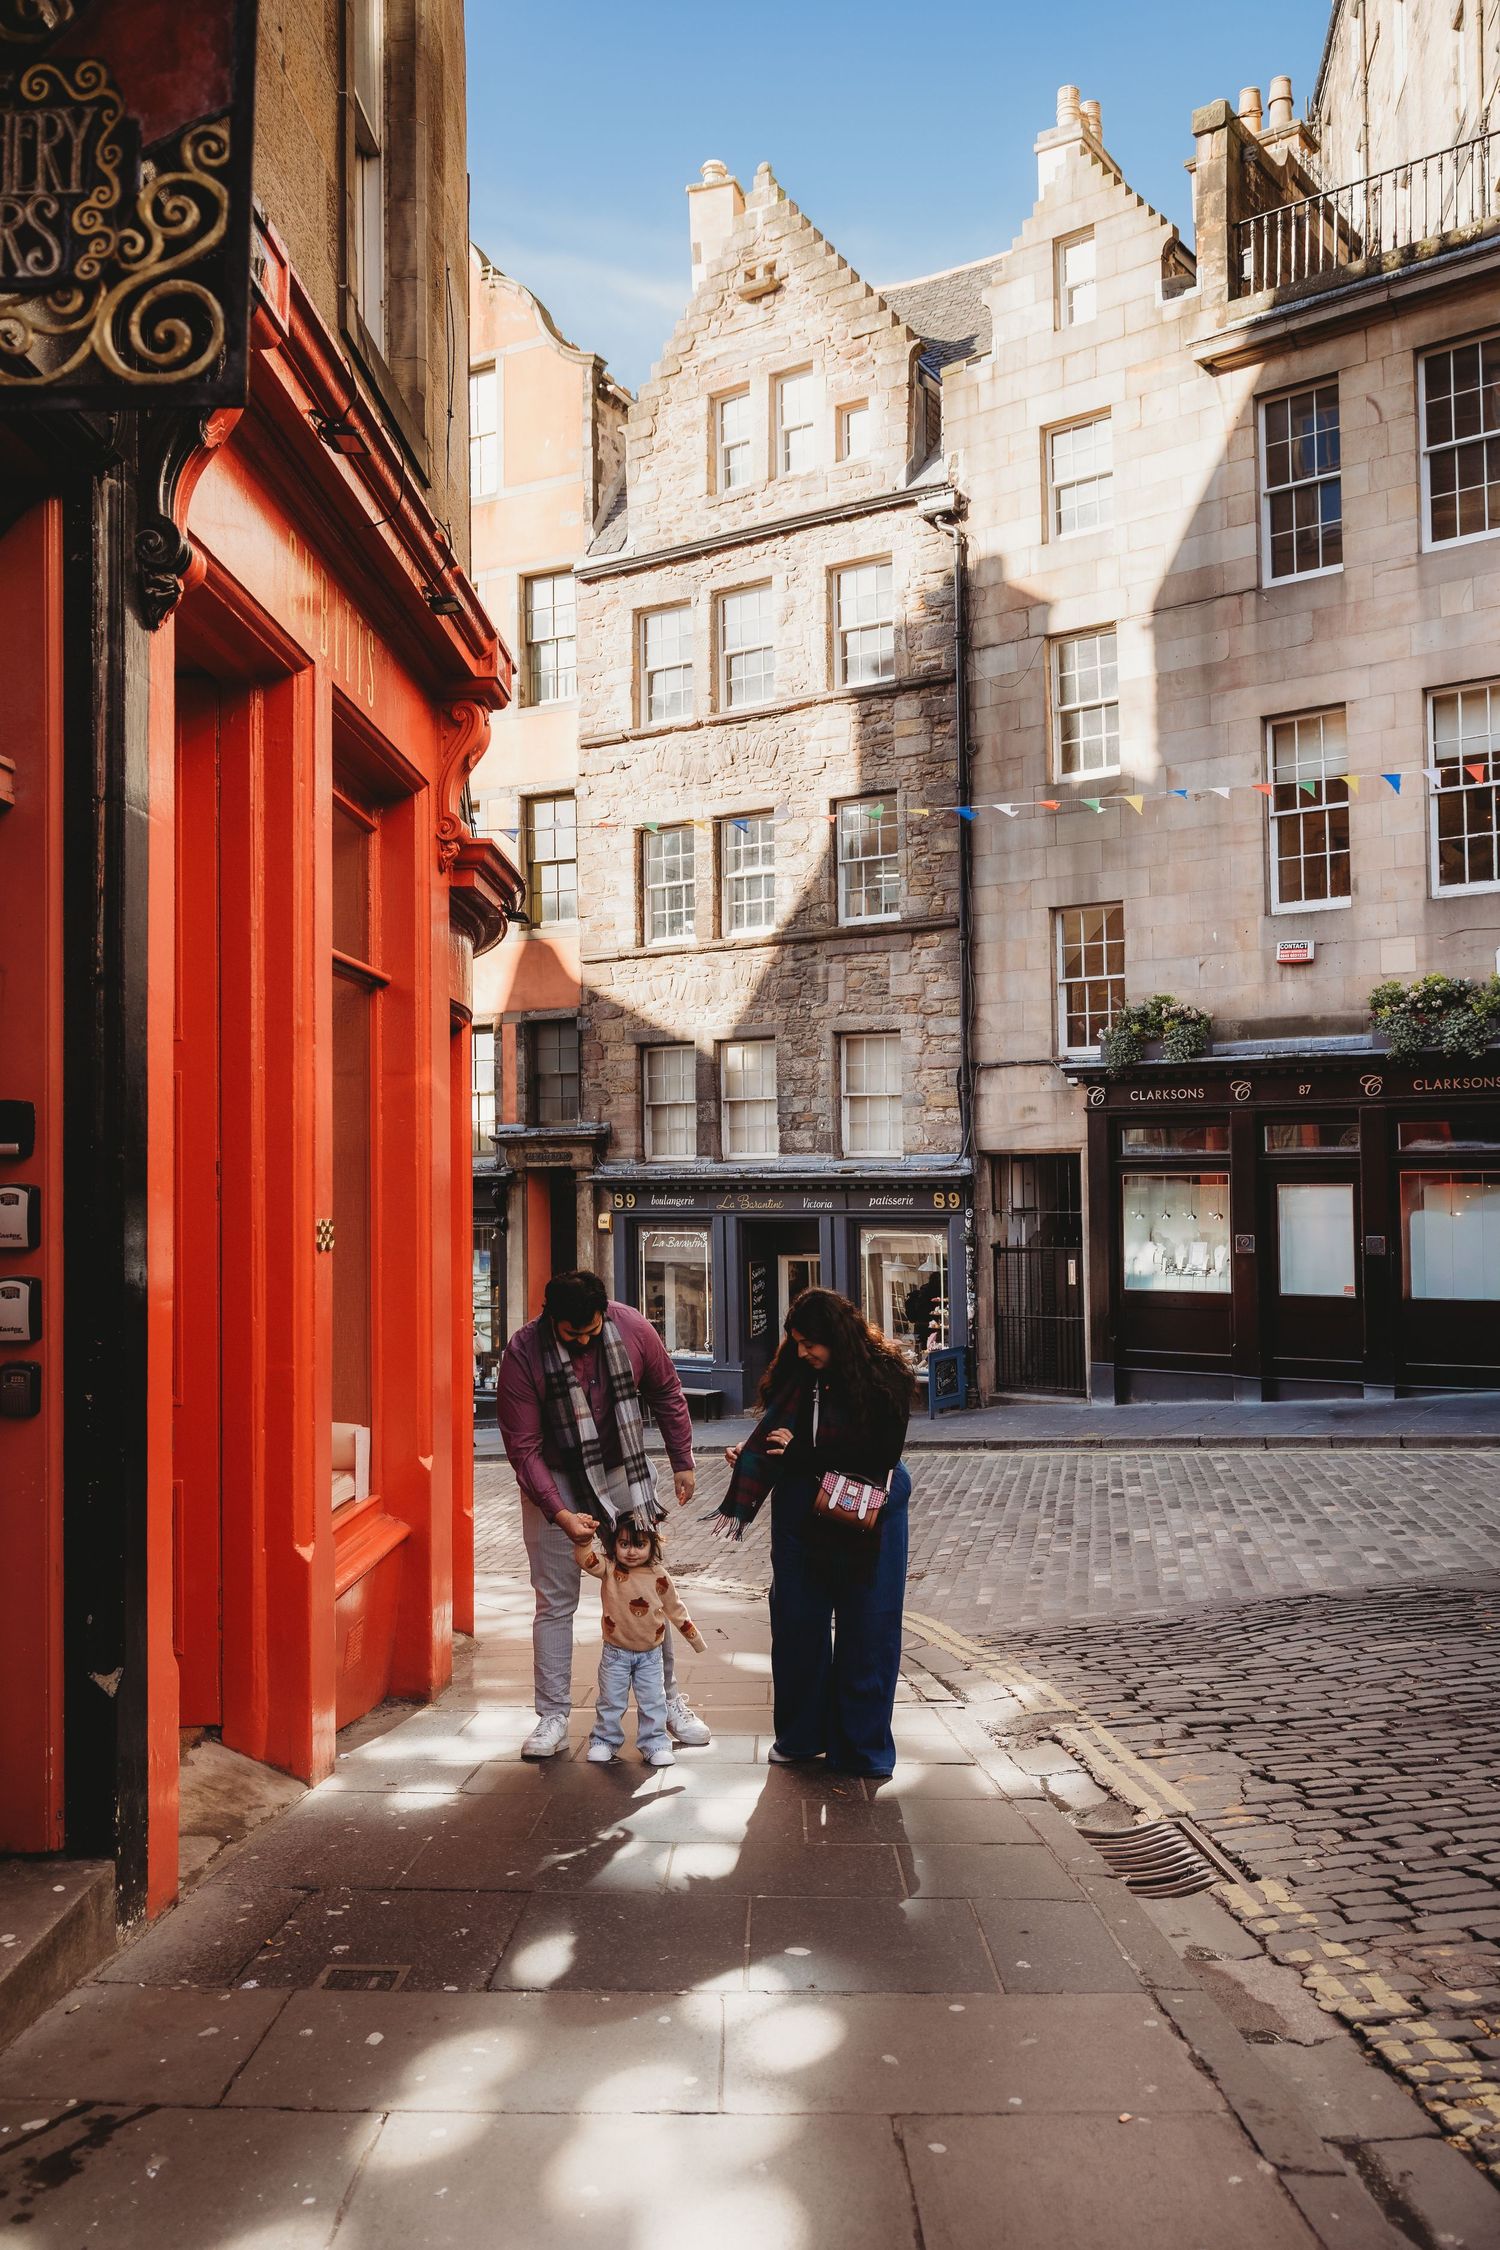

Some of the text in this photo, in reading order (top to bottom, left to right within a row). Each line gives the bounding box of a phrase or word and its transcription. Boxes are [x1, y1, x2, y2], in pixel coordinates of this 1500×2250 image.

[287, 529, 375, 708] CUBITTS
[1130, 1088, 1205, 1101] CLARKSONS
[1298, 1084, 1311, 1095] 87
[614, 1193, 636, 1208] 89
[650, 1194, 695, 1207] boulangerie
[716, 1194, 785, 1209] La Barantine
[802, 1197, 833, 1209] Victoria
[868, 1194, 914, 1208] patisserie
[933, 1192, 961, 1209] 89
[652, 1236, 665, 1248] La
